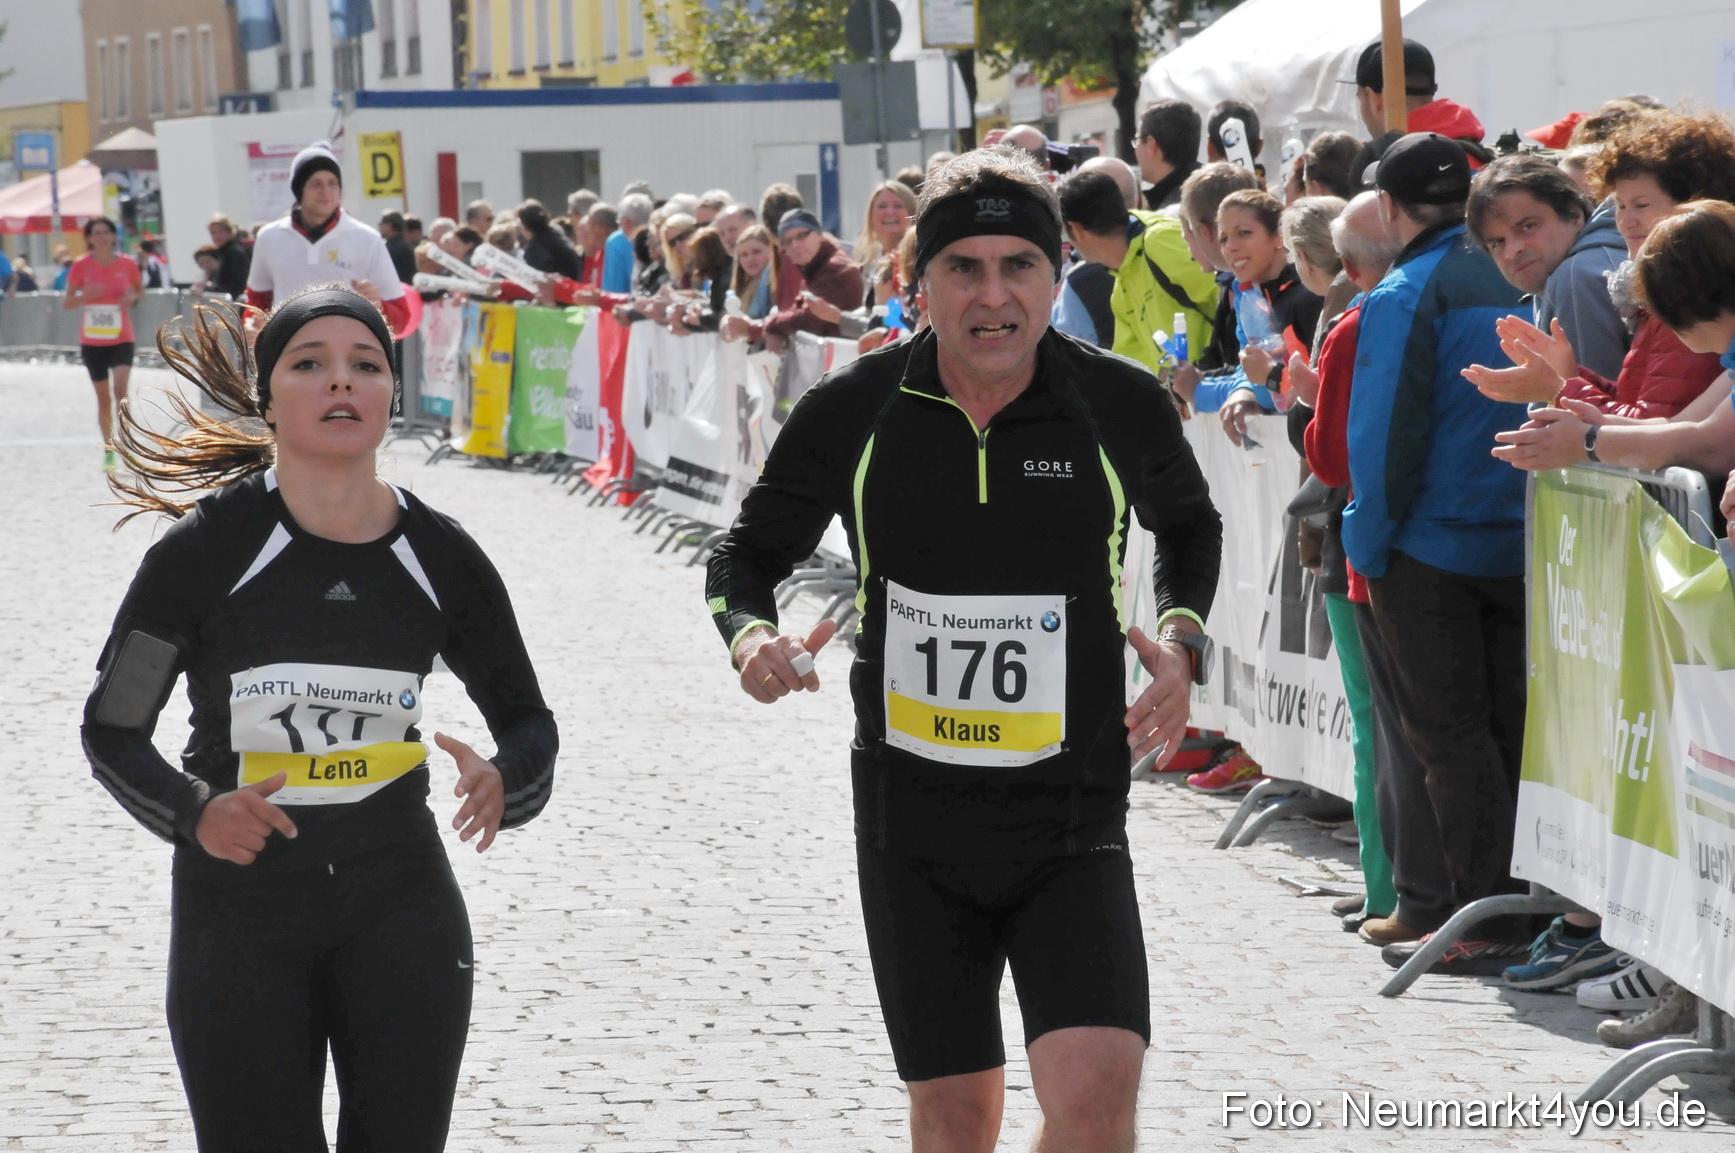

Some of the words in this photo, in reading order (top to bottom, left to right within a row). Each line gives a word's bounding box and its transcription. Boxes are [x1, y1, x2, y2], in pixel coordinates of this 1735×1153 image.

[371, 152, 394, 184] D
[1023, 460, 1073, 473] GORE
[1559, 514, 1577, 566] Der
[890, 598, 937, 627] PARTL
[942, 613, 1033, 630] Neumarkt
[1547, 562, 1588, 660] Neue
[915, 636, 1027, 703] 176
[236, 681, 301, 698] PARTL
[306, 682, 393, 706] Neumarkt
[934, 715, 1001, 743] Klaus
[308, 758, 368, 780] Lena
